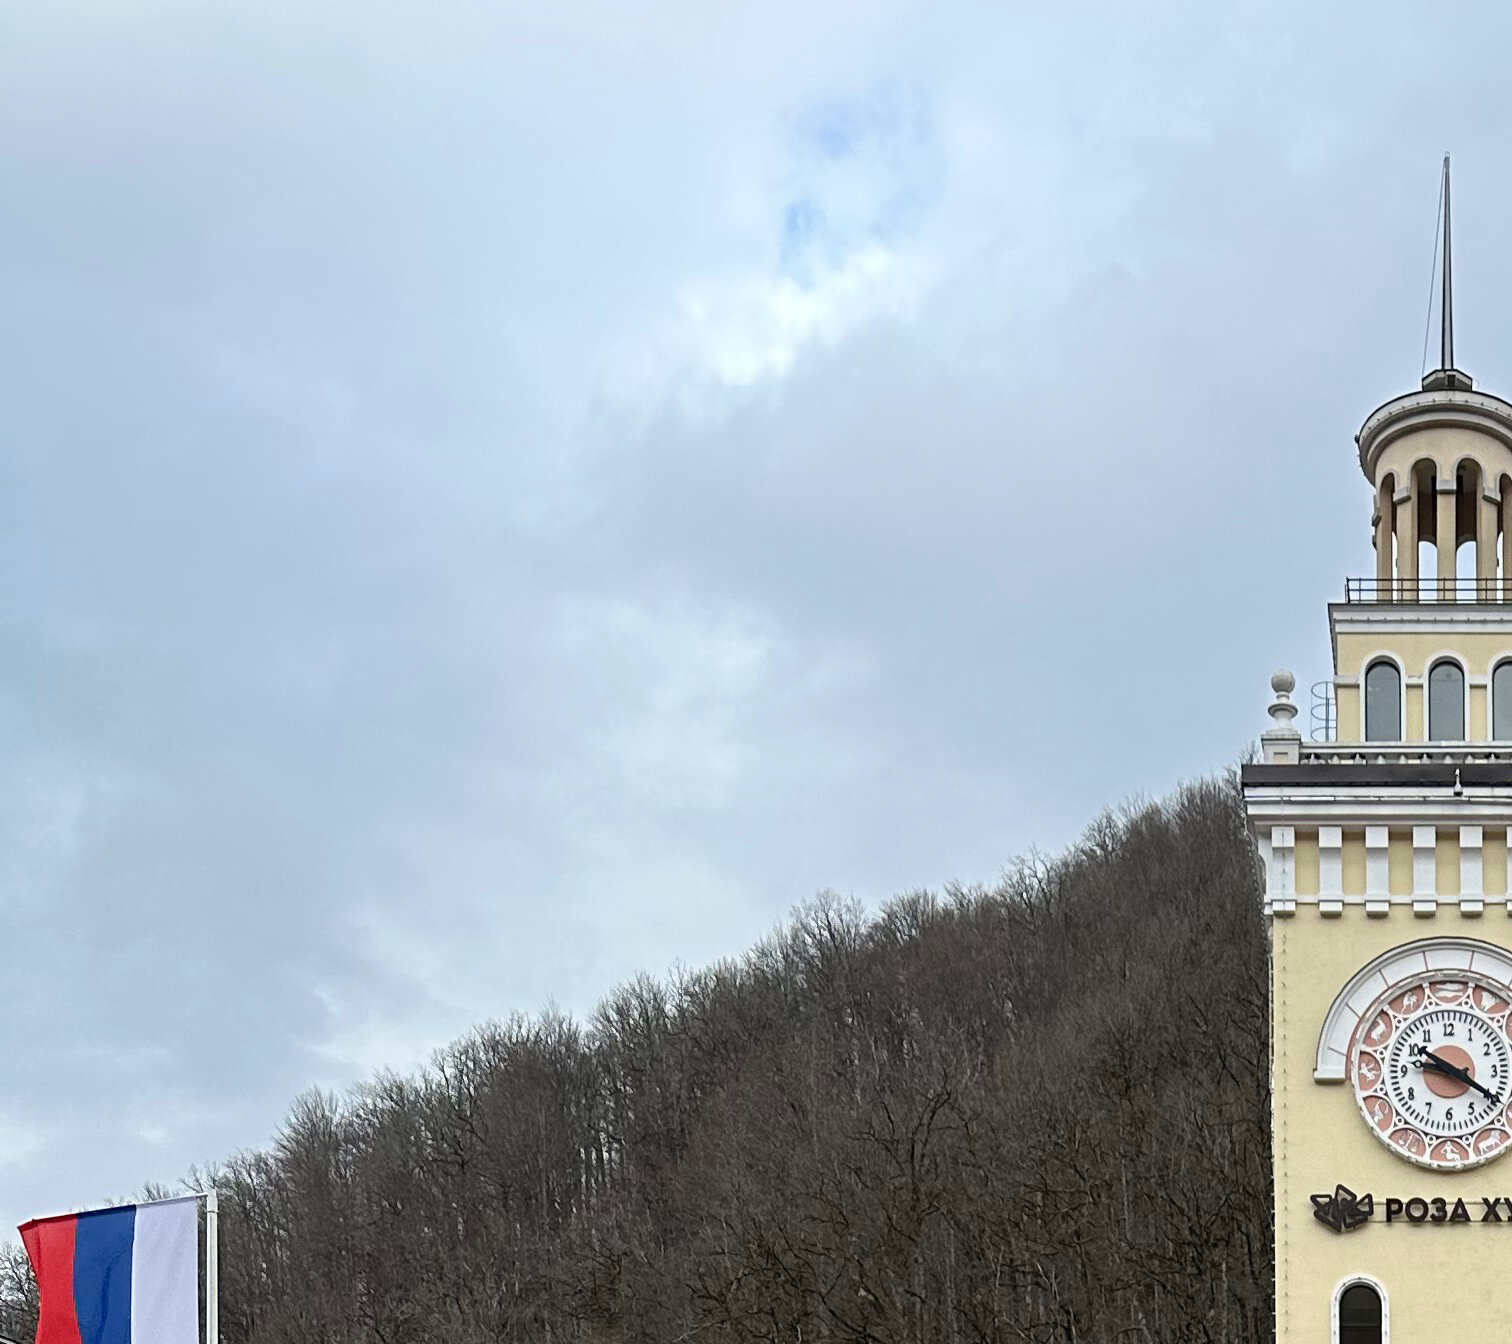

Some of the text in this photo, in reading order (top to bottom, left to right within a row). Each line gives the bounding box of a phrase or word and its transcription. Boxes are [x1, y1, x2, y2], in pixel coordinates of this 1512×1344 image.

[1422, 1029, 1432, 1043] 11
[1443, 1023, 1455, 1036] 12
[1467, 1028, 1473, 1042] 1
[1408, 1043, 1420, 1057] 10
[1483, 1042, 1491, 1056] 2
[1400, 1064, 1408, 1078] 9
[1490, 1064, 1498, 1078] 3
[1407, 1086, 1415, 1101] 8
[1425, 1101, 1432, 1115] 7
[1445, 1106, 1453, 1121] 6
[1467, 1101, 1475, 1116] 5
[1385, 1196, 1472, 1223] РОЗА
